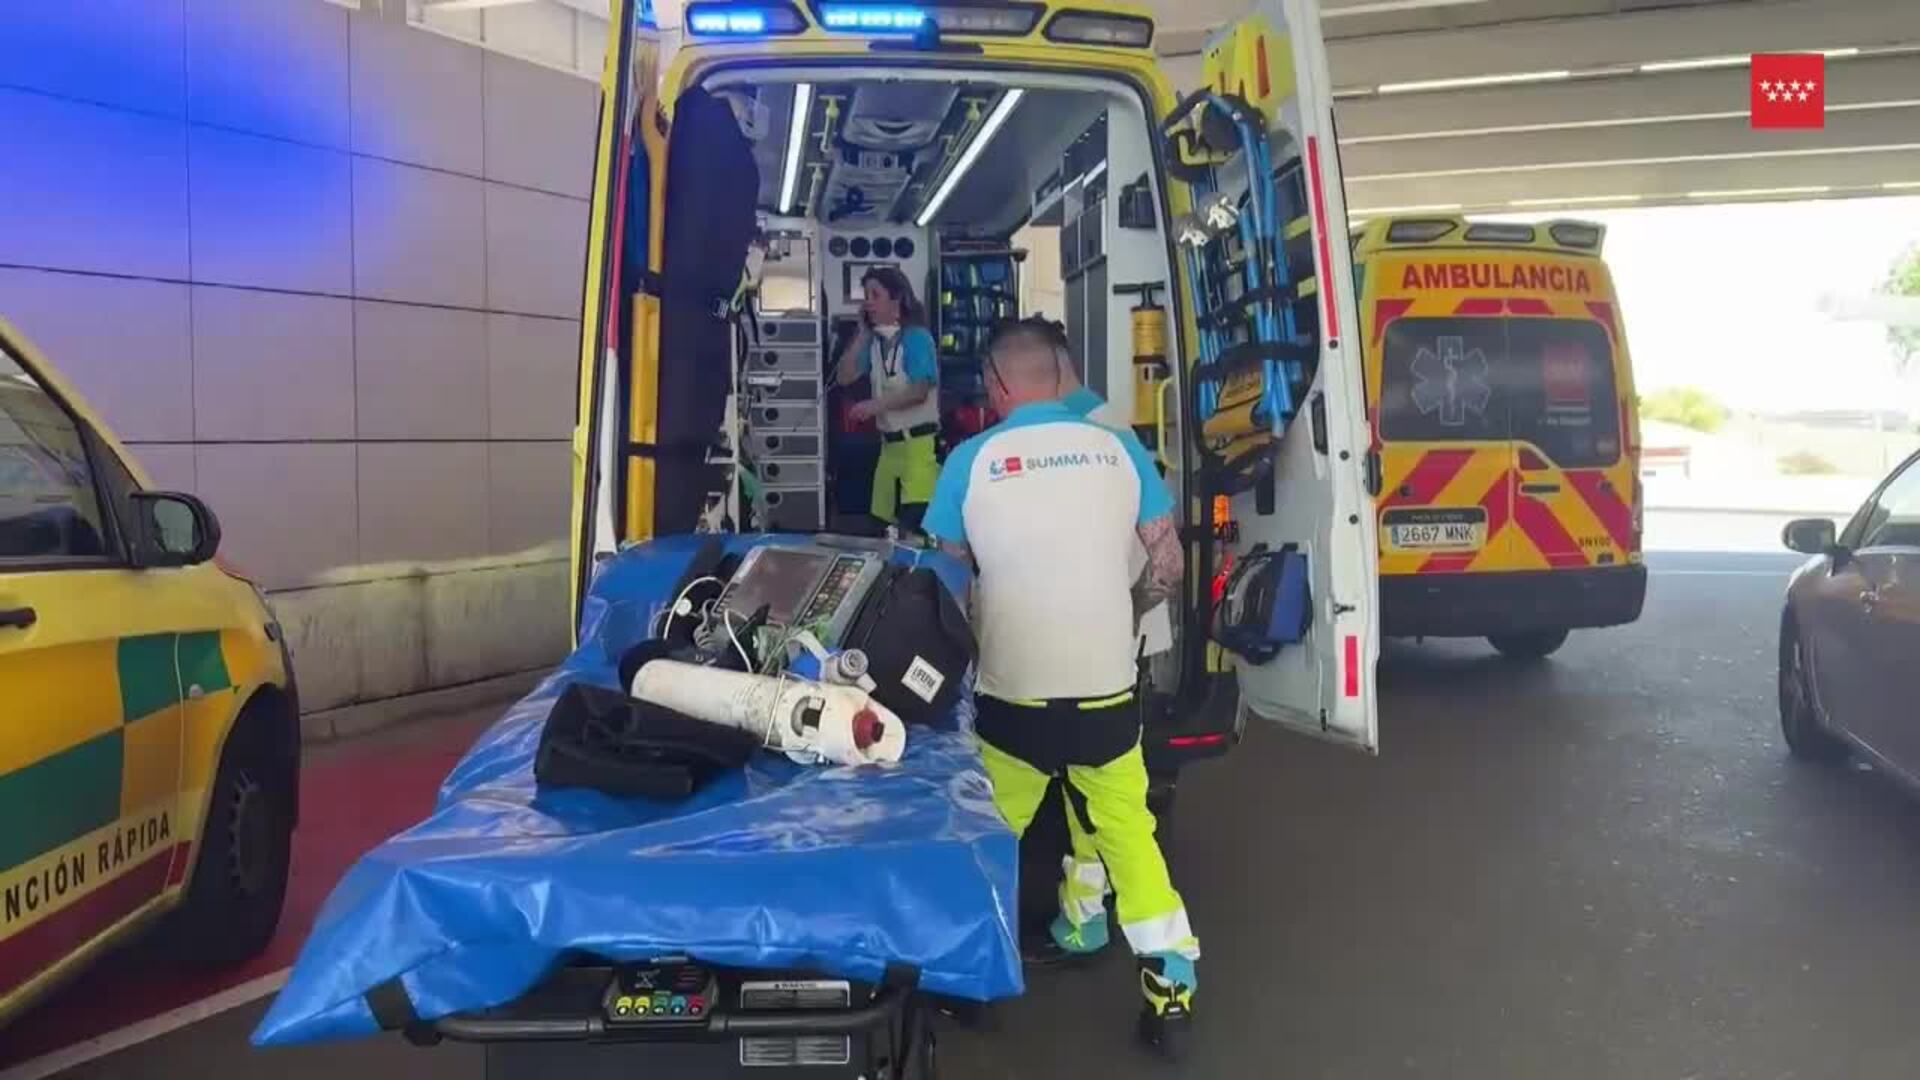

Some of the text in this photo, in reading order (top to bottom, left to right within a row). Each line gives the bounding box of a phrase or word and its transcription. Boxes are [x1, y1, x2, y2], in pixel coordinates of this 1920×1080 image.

[1402, 263, 1591, 292] AMBULANCIA
[1026, 453, 1119, 470] SUMMA 112
[1402, 525, 1473, 541] 2667 MNK
[4, 811, 170, 923] NCIÓN RÁPIDA
